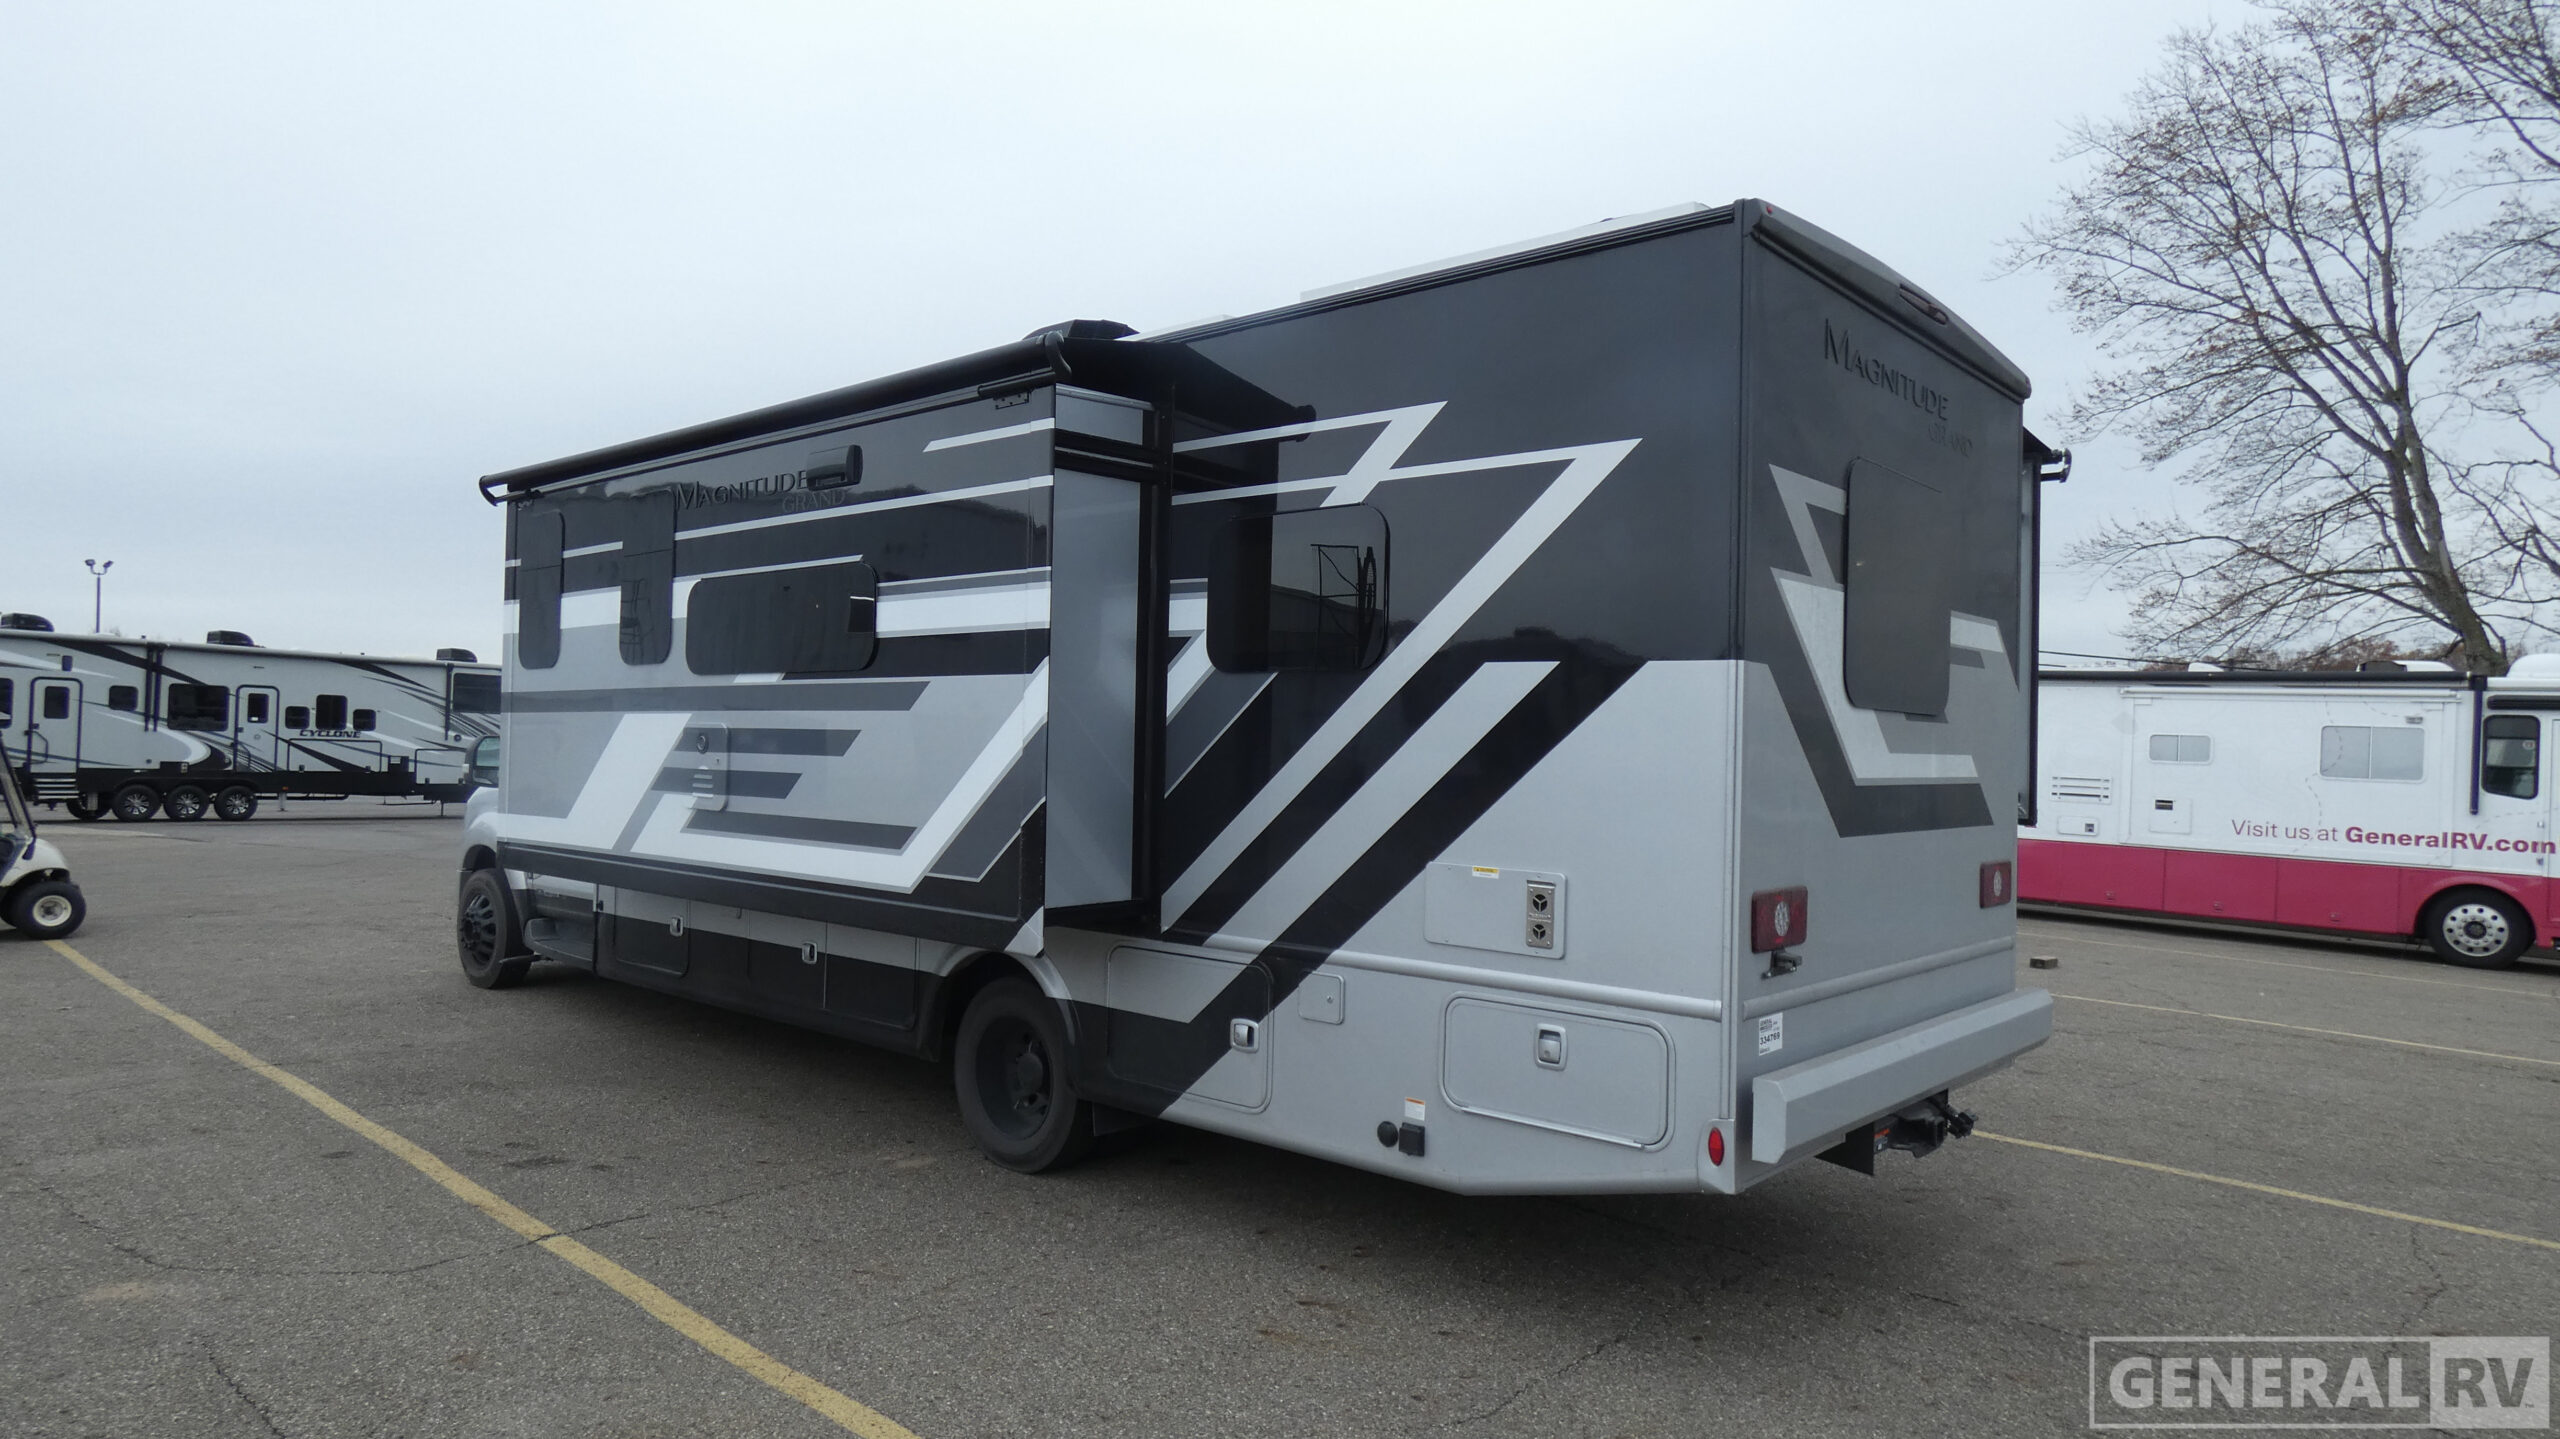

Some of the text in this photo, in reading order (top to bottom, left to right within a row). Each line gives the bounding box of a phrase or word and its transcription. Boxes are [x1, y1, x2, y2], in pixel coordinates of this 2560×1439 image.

[1823, 318, 1949, 421] MAGNITUDE
[675, 470, 809, 511] MAGNITUDE
[782, 489, 845, 513] GRAND
[299, 729, 361, 738] CYCLONE
[2231, 819, 2556, 854] Visit us at GeneralRV.com
